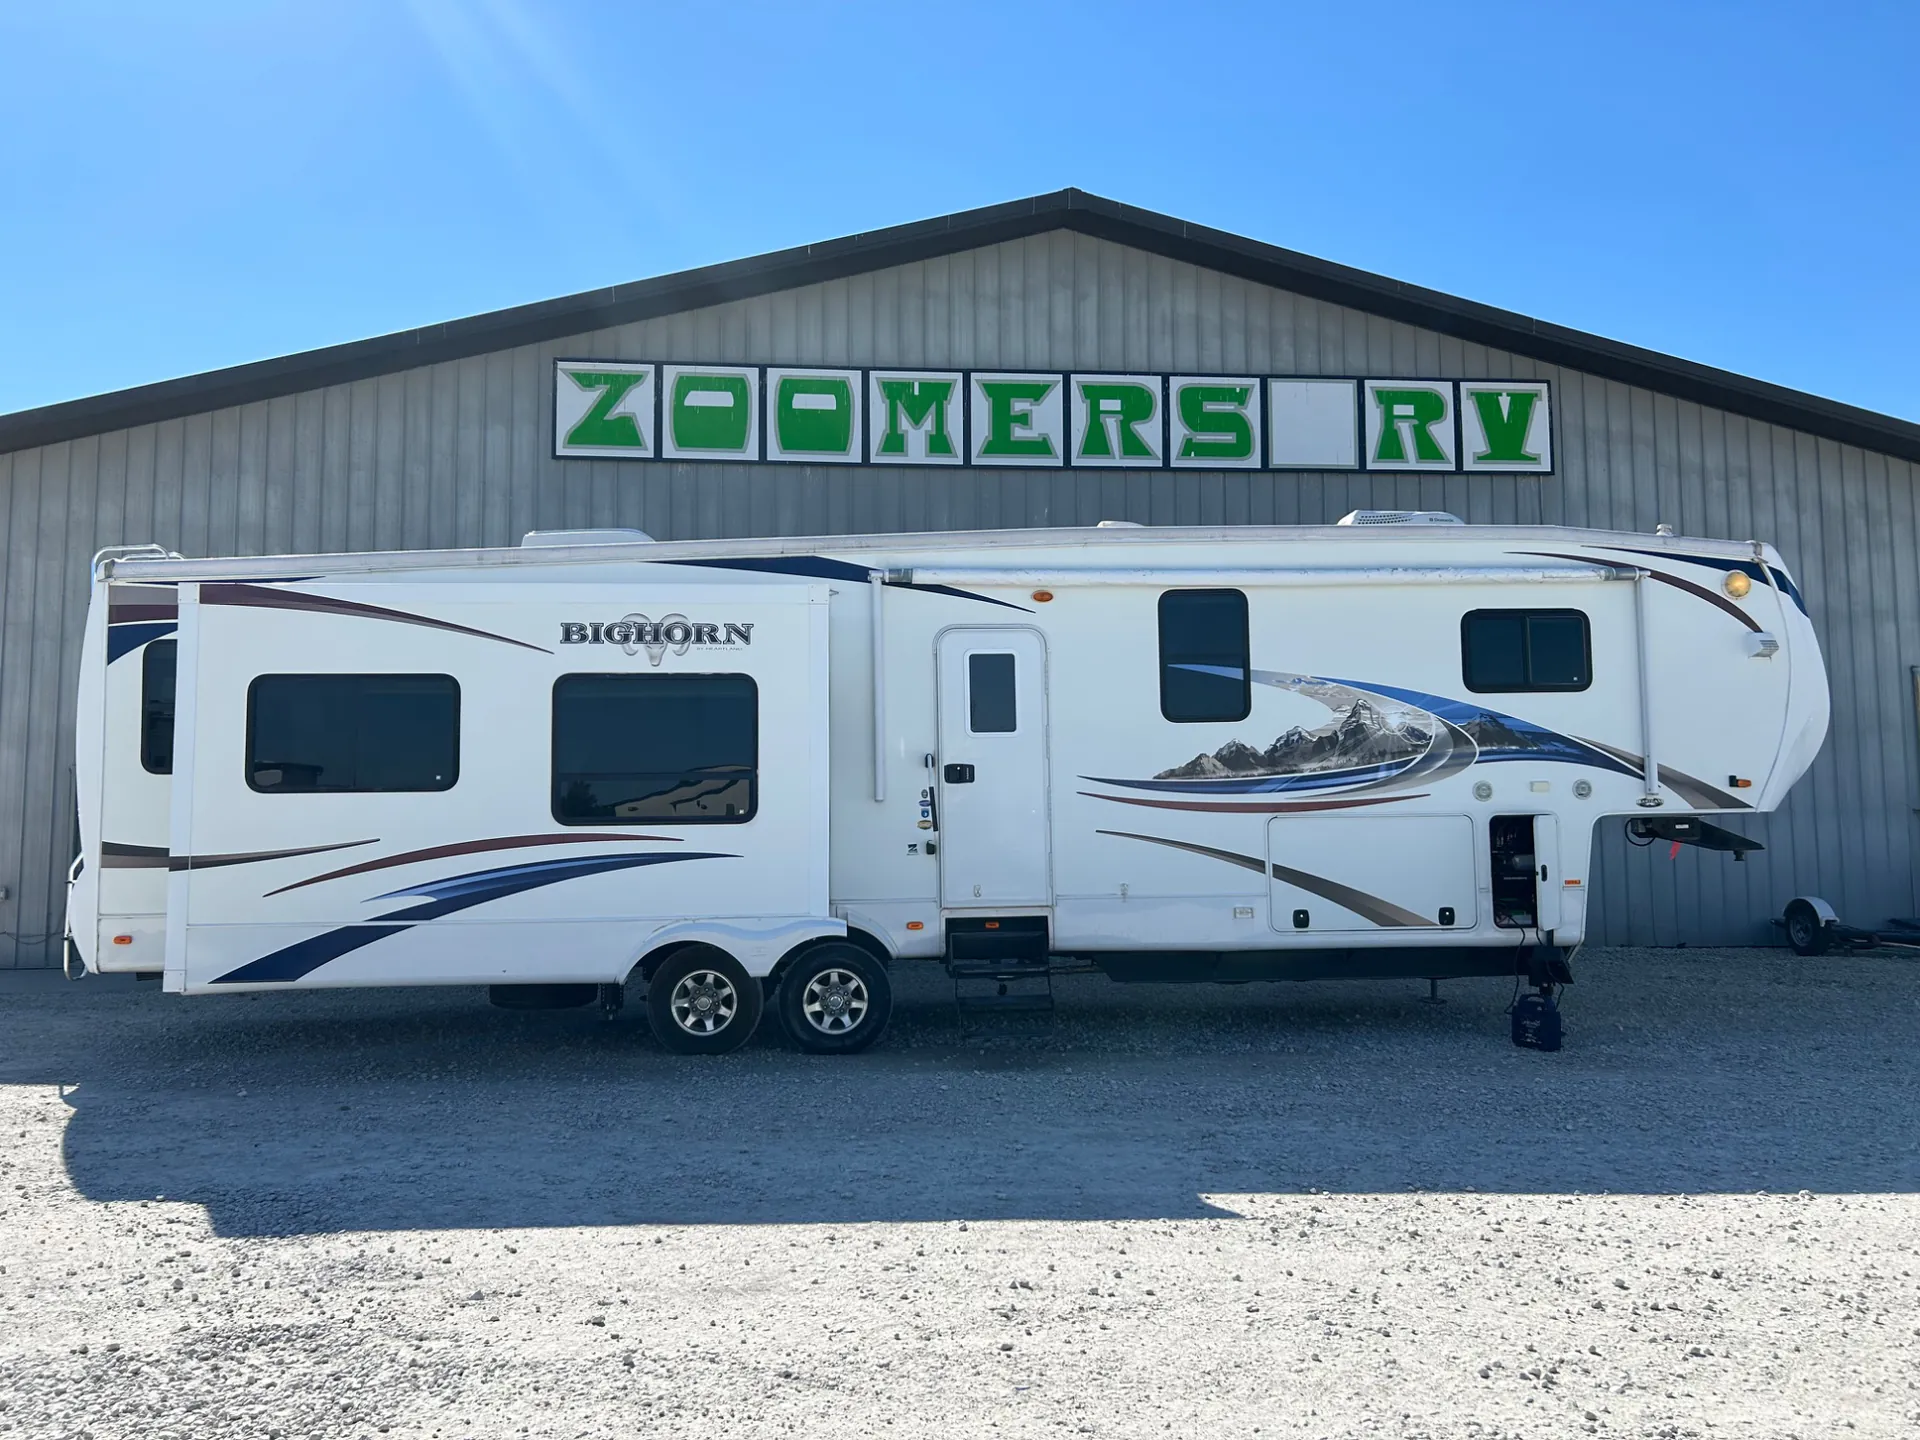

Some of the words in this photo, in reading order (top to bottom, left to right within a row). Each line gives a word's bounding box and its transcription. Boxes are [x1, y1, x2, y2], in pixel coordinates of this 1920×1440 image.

[559, 367, 1254, 462] ZOOMERS
[1371, 386, 1543, 465] RV
[560, 622, 754, 645] BIGHORN
